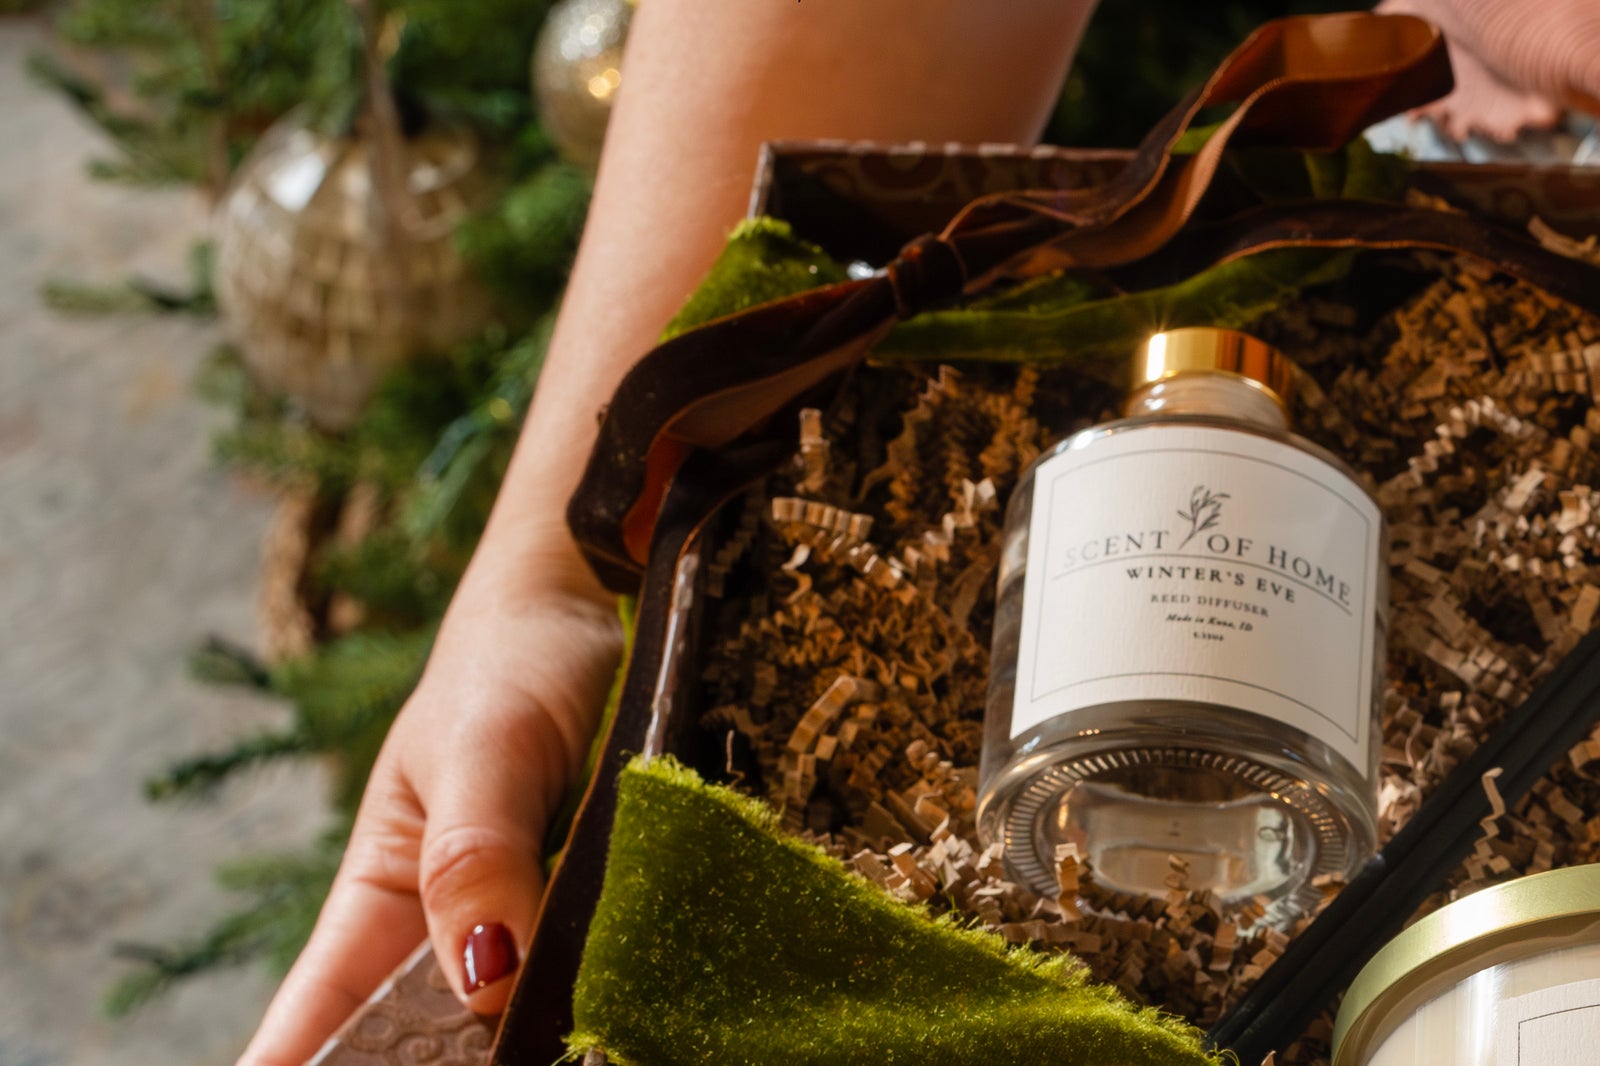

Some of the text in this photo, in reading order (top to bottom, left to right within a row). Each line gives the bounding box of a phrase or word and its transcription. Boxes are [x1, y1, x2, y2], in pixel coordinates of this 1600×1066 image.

[1064, 530, 1352, 606] SCENT OF HOME
[1127, 568, 1296, 603] WINTER'S EVE
[1151, 594, 1269, 617] REED DIFFUSER
